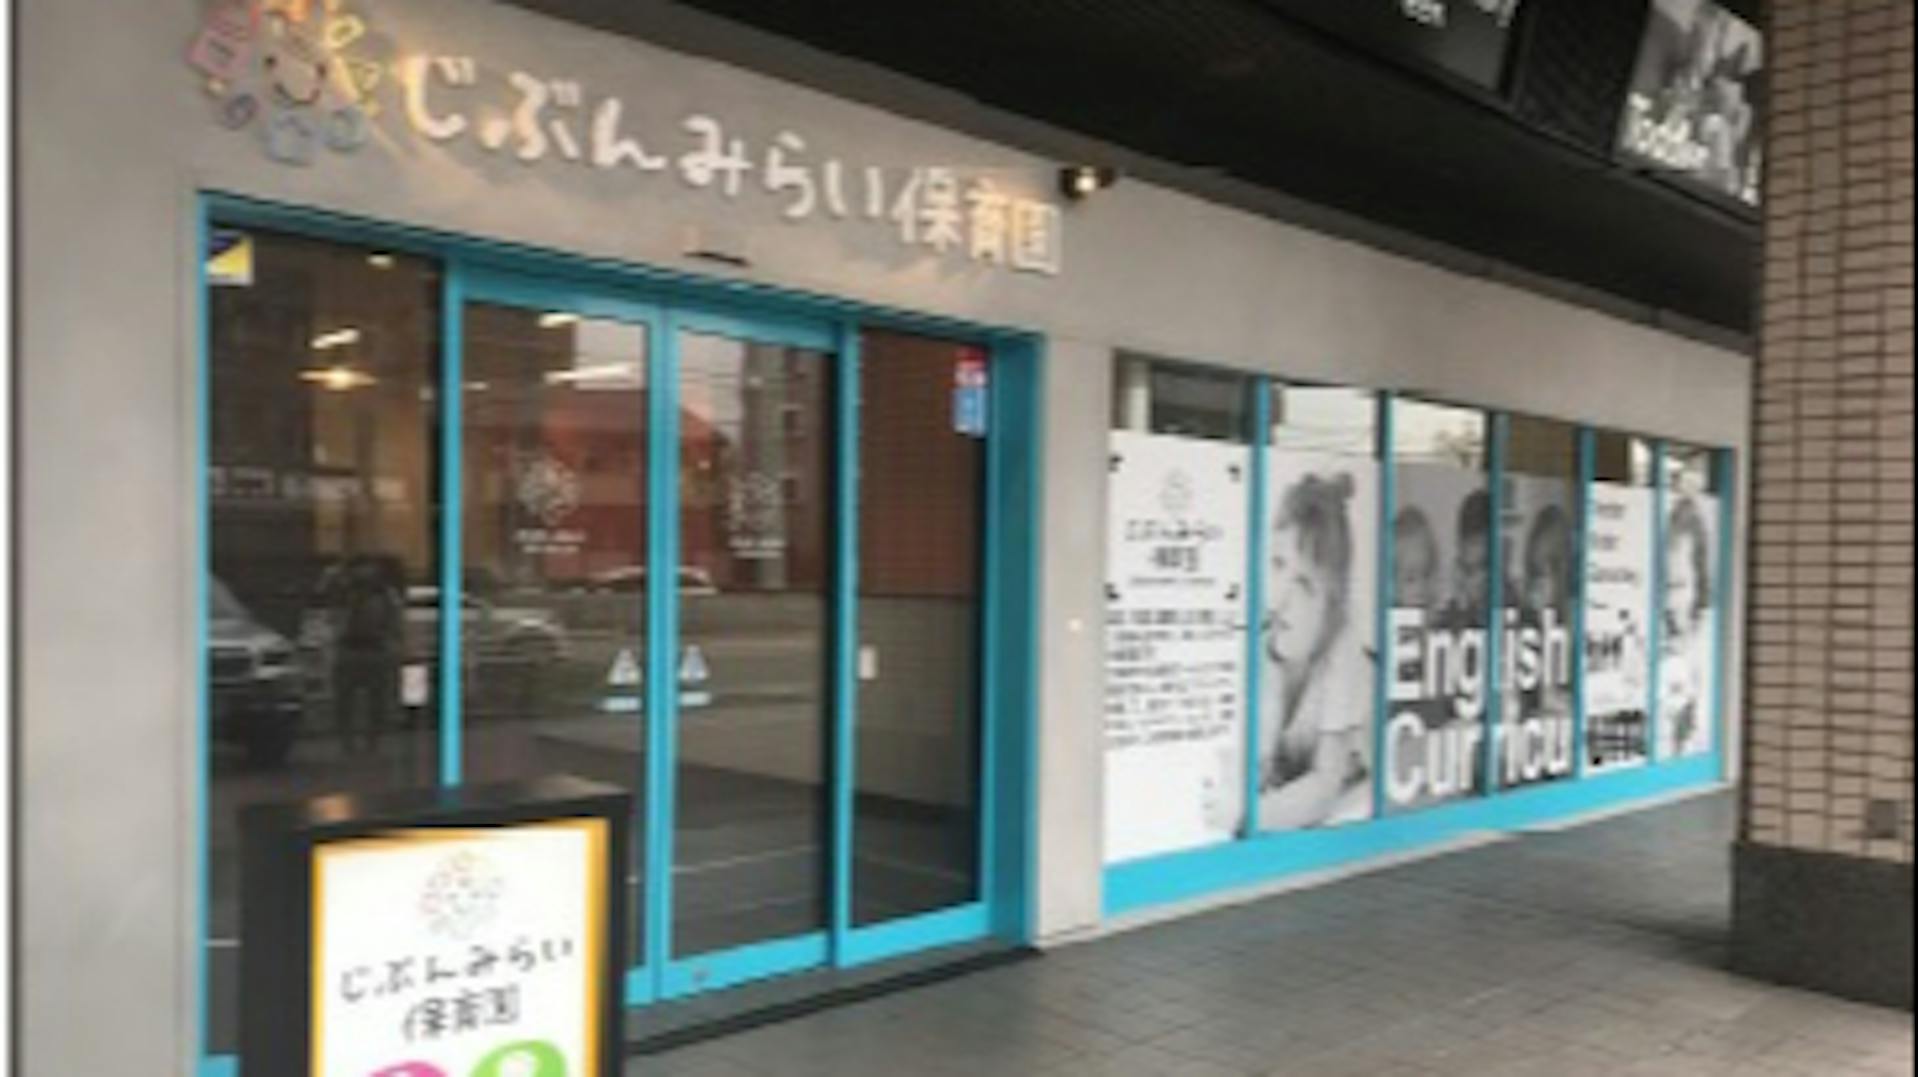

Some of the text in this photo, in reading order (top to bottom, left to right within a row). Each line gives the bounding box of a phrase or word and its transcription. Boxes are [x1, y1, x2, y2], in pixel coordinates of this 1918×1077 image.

[401, 52, 1061, 275] じぶんみらい保育園
[339, 935, 574, 1002] じぶんみらい
